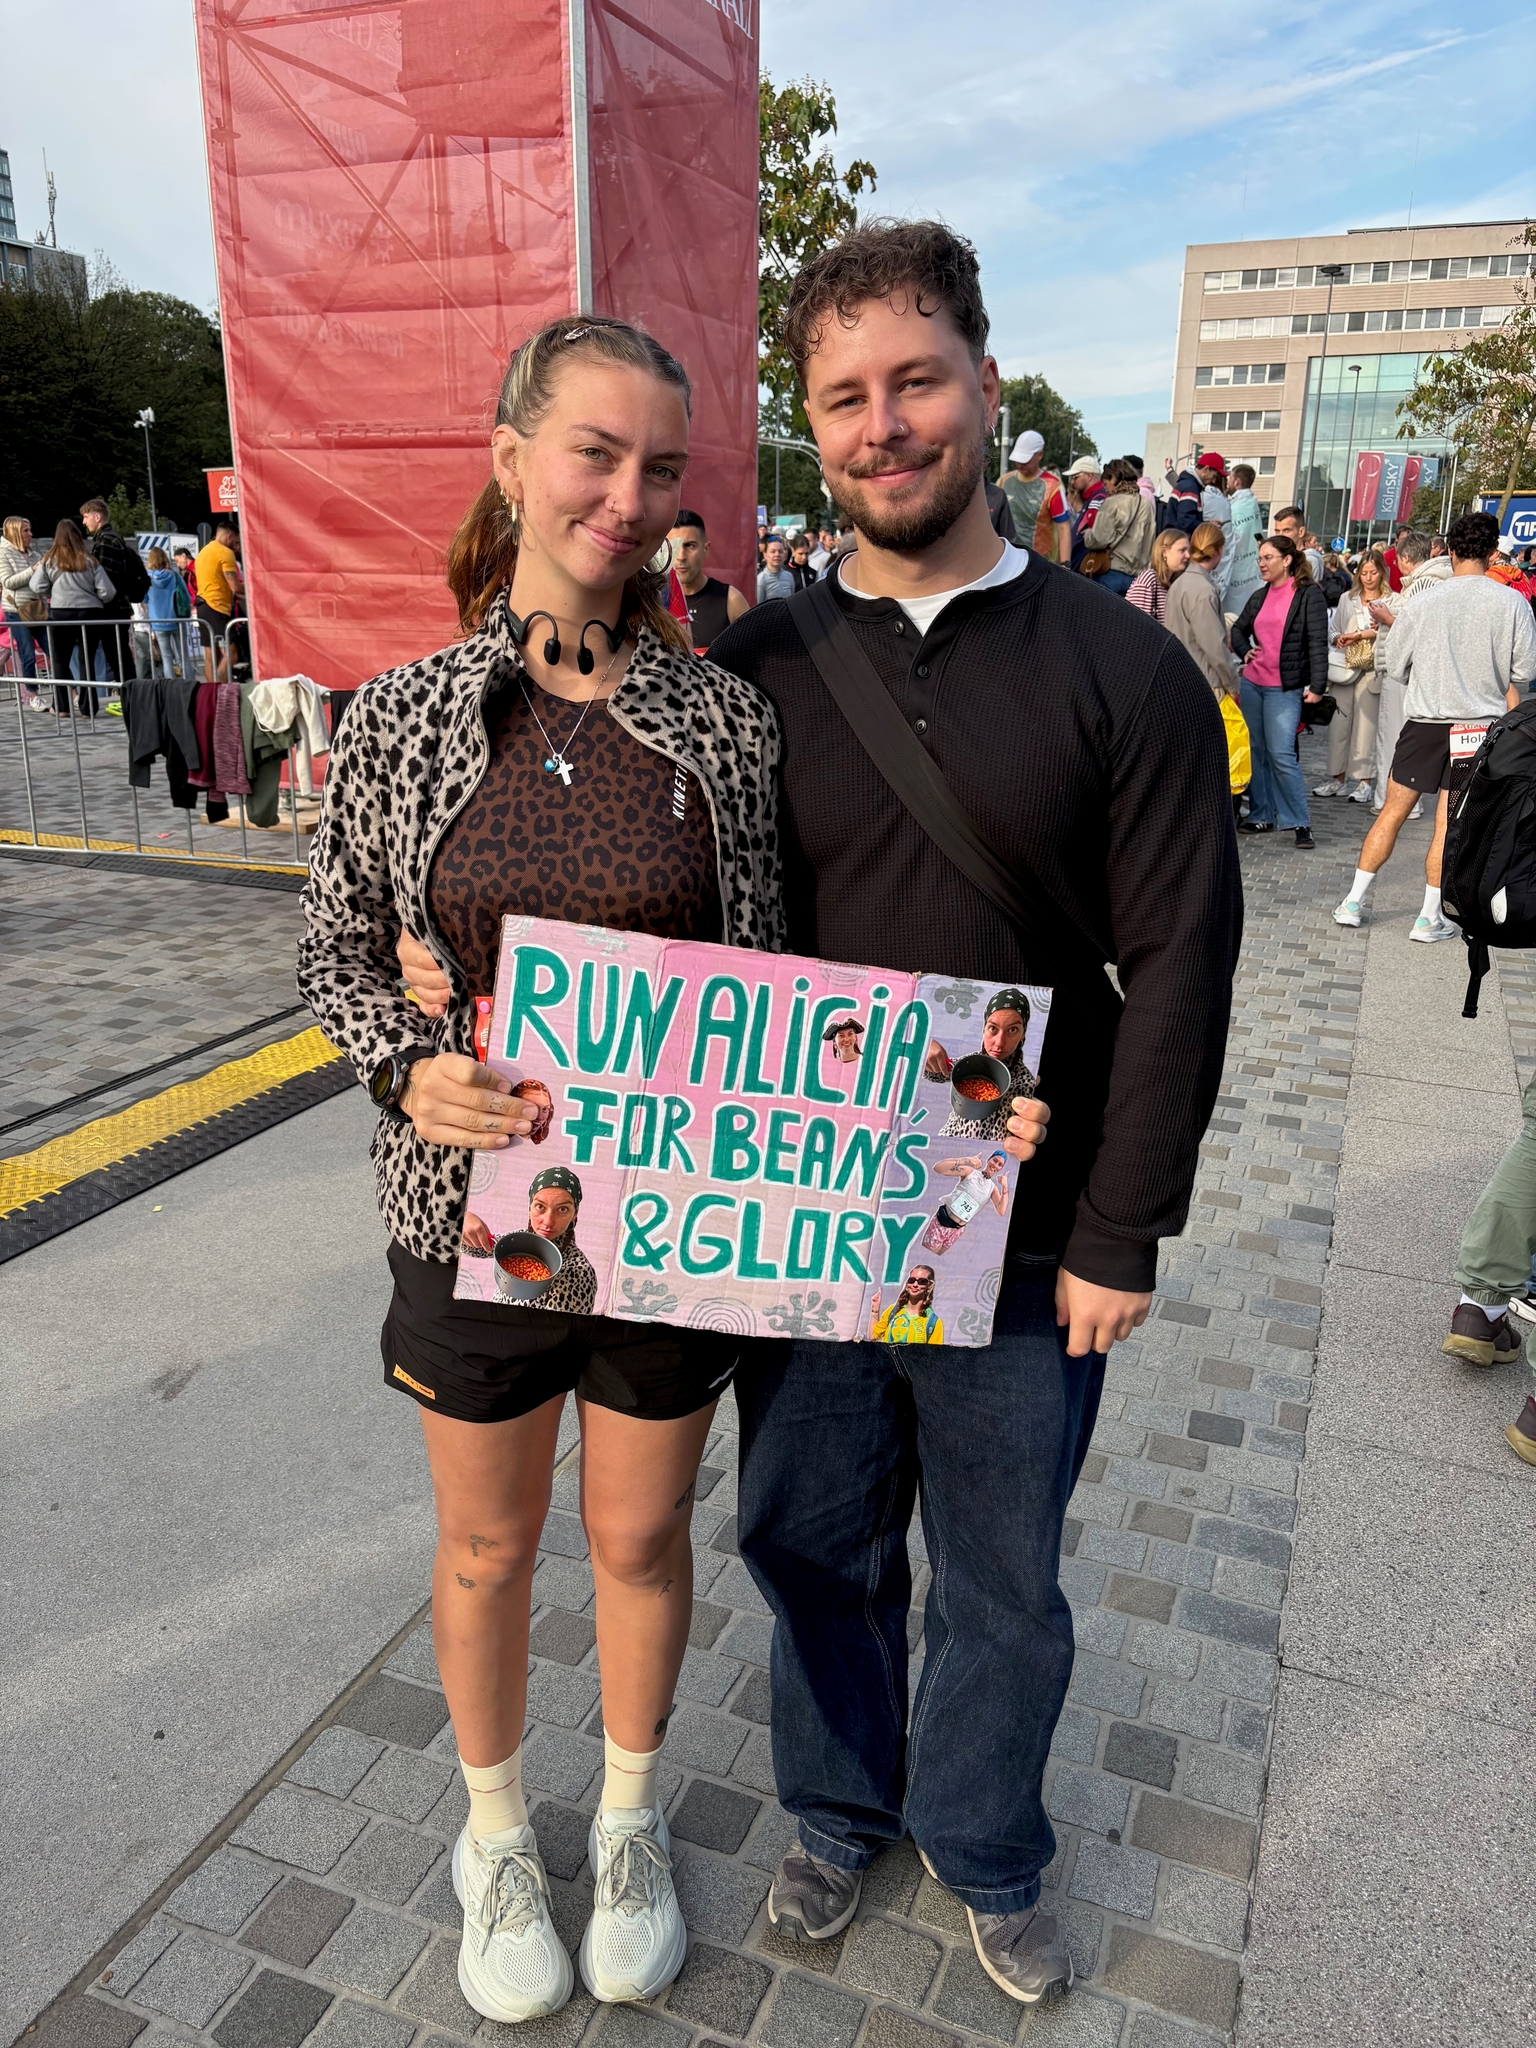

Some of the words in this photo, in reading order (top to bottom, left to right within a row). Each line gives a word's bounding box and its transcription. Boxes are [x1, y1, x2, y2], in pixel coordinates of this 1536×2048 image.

[1381, 462, 1400, 513] KölnSKY
[503, 944, 686, 1079] RUN
[561, 1086, 696, 1175] FOR
[709, 1103, 930, 1201] BEANS
[960, 1201, 972, 1213] 743
